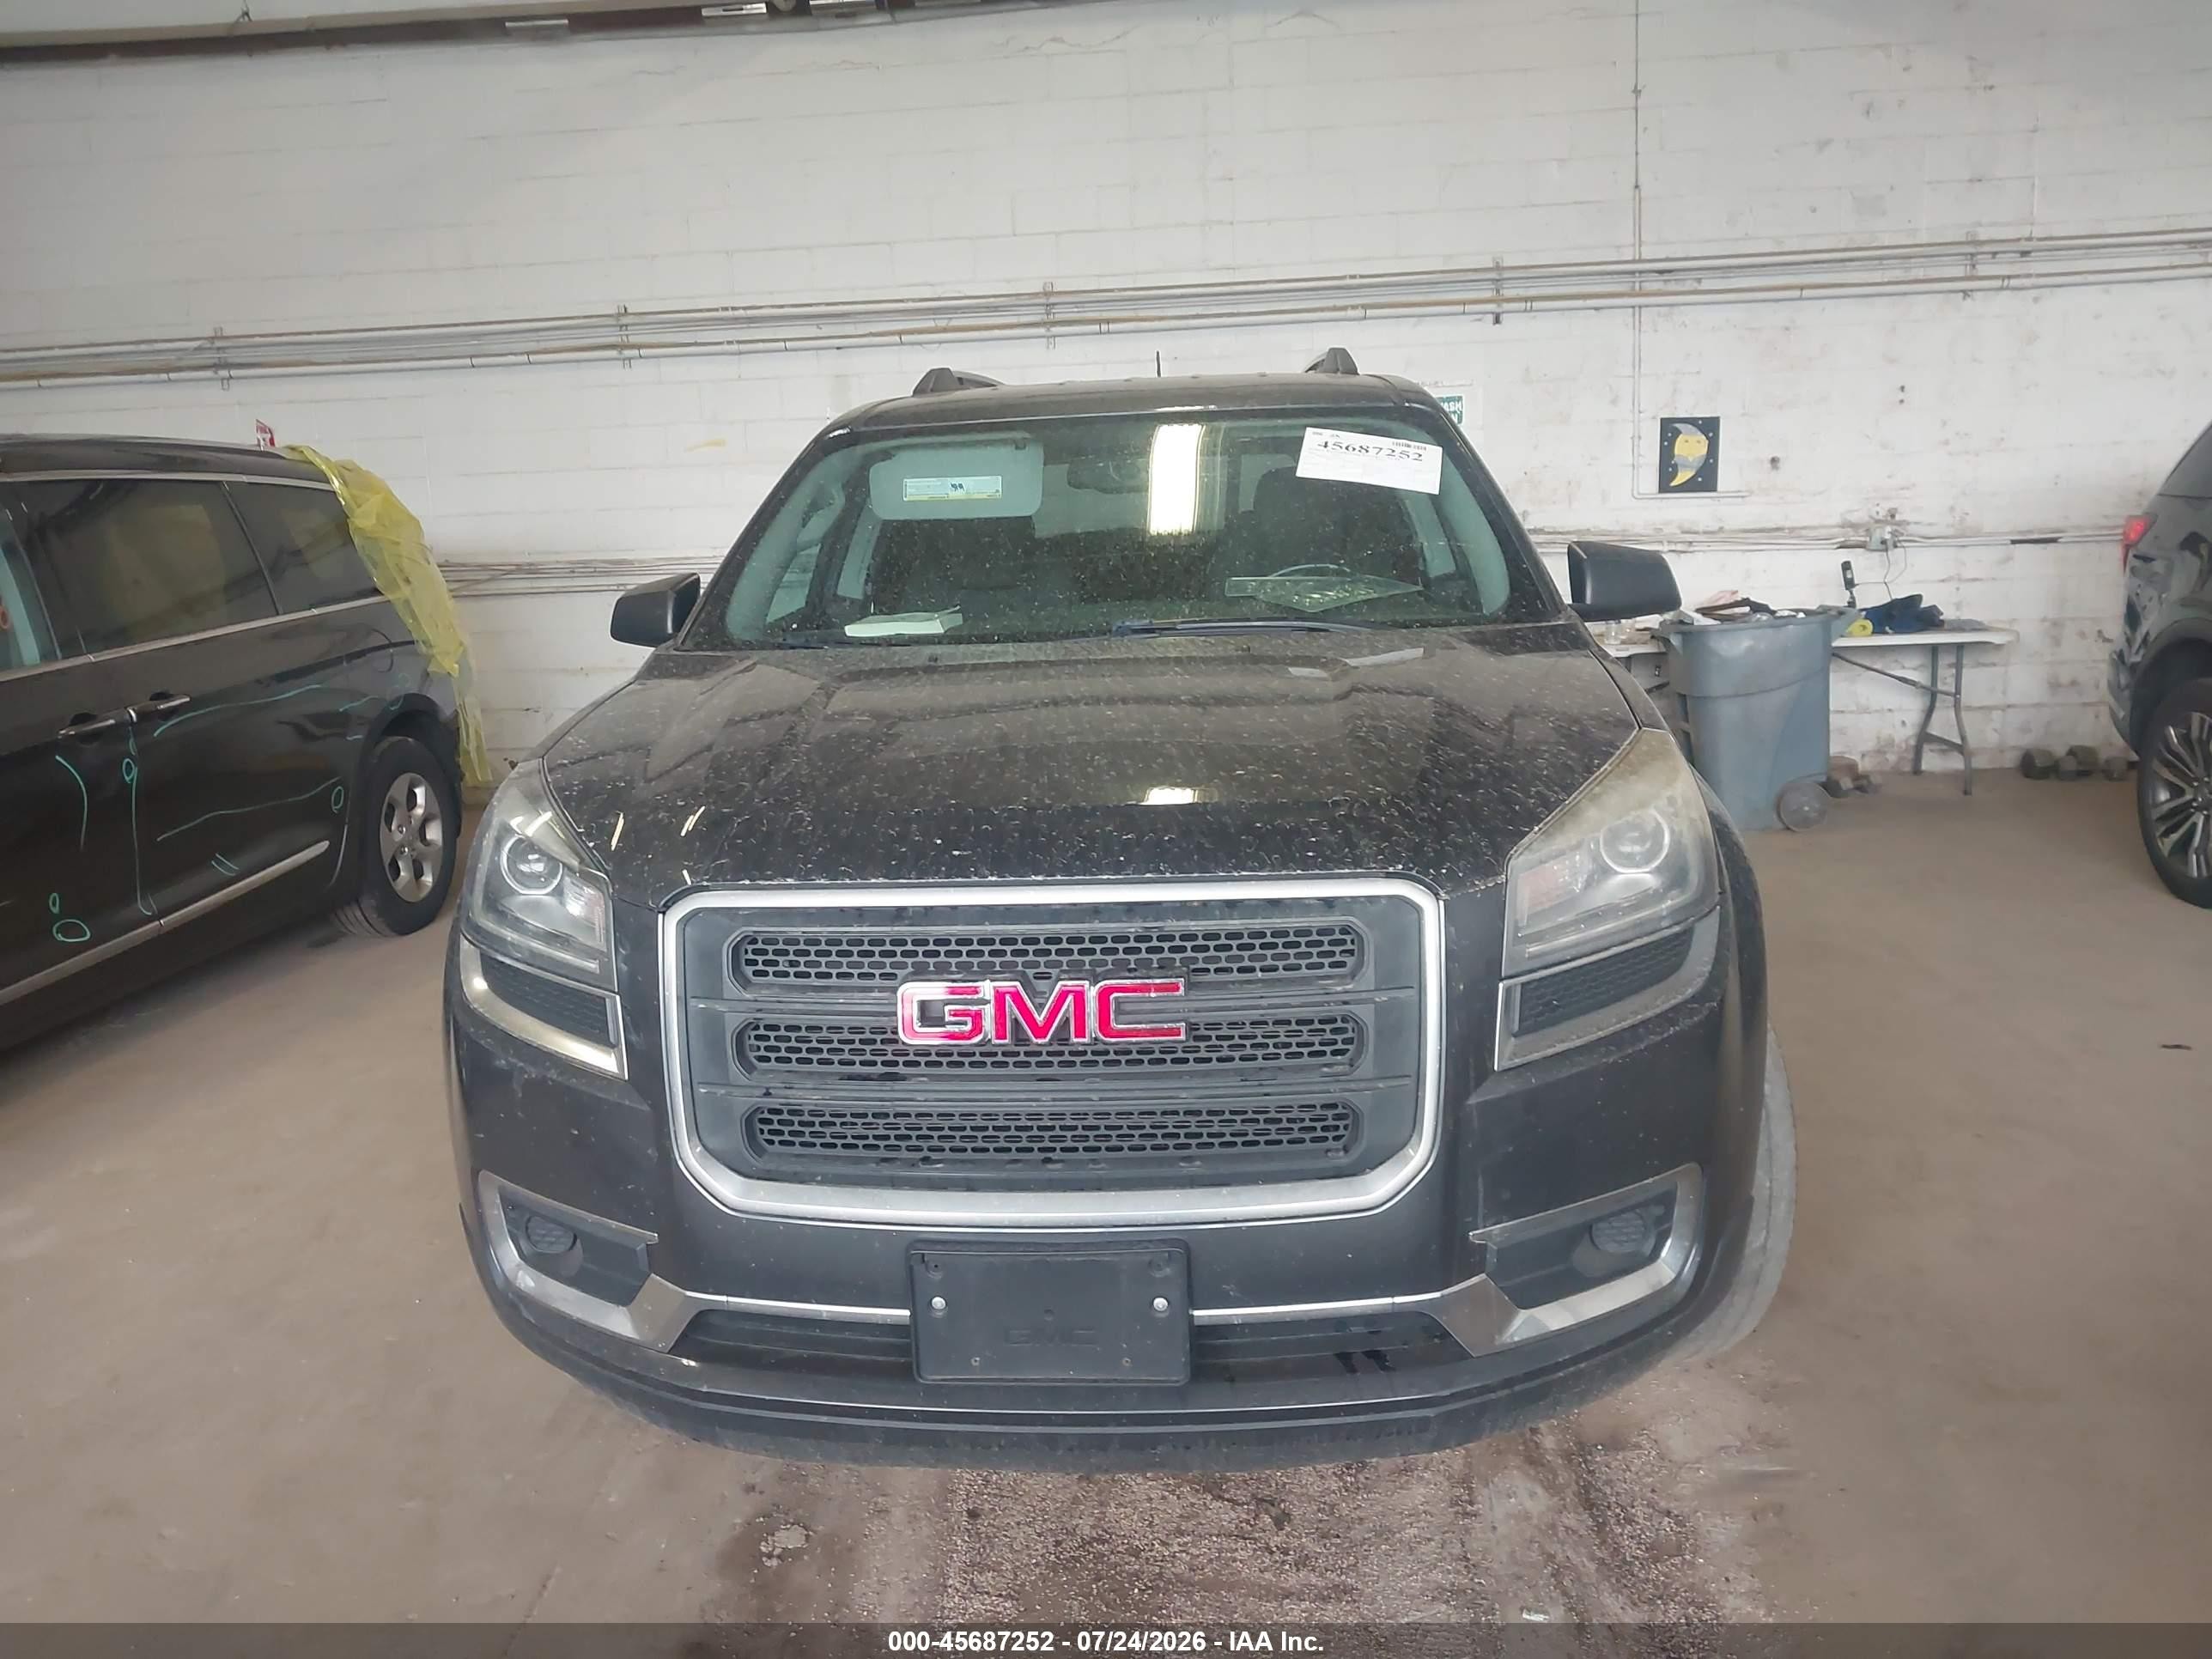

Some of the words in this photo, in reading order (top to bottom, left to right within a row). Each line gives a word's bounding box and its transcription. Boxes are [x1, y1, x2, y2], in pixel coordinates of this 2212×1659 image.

[1441, 400, 1462, 412] ASH
[1316, 440, 1424, 462] 45687252
[896, 978, 1186, 1045] GMC
